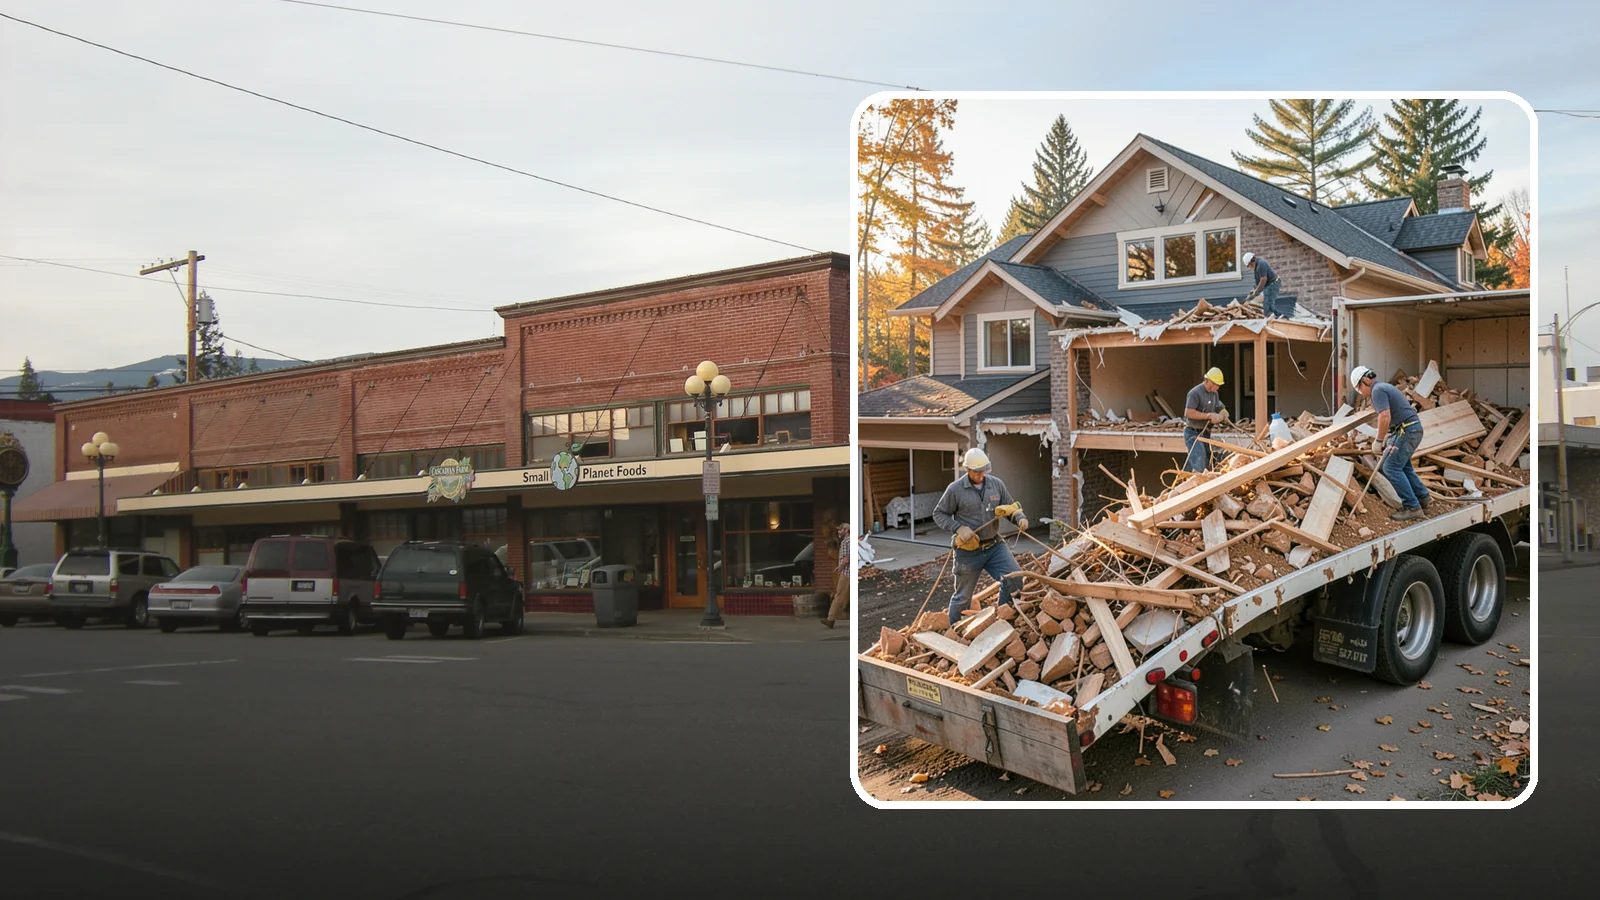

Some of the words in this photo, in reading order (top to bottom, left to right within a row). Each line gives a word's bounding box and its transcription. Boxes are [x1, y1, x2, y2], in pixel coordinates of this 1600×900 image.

[523, 471, 549, 483] Small
[583, 467, 614, 479] Planet
[617, 464, 647, 477] Foods
